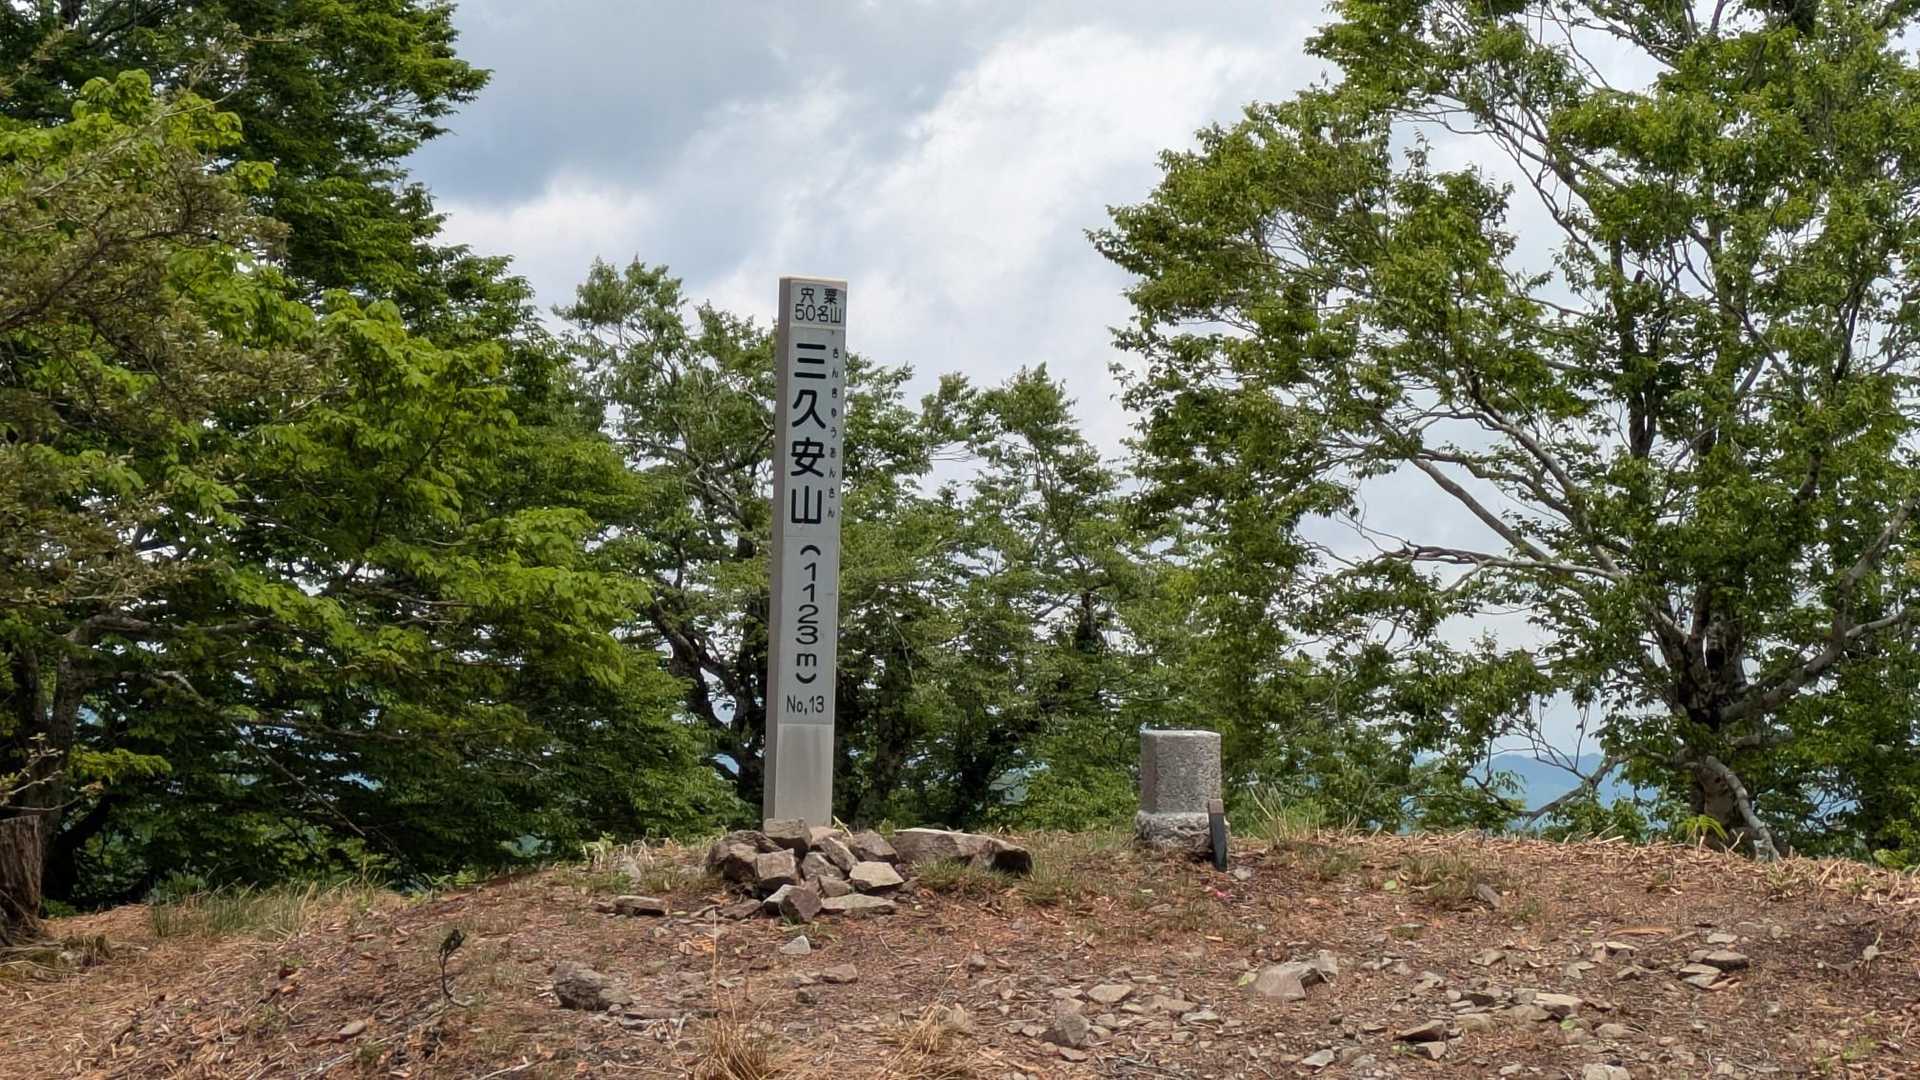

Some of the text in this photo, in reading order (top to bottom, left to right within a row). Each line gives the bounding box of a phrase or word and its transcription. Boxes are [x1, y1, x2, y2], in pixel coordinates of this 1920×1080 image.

[795, 303, 842, 323] 50名山
[791, 343, 826, 684] 三久安山 (1123m)
